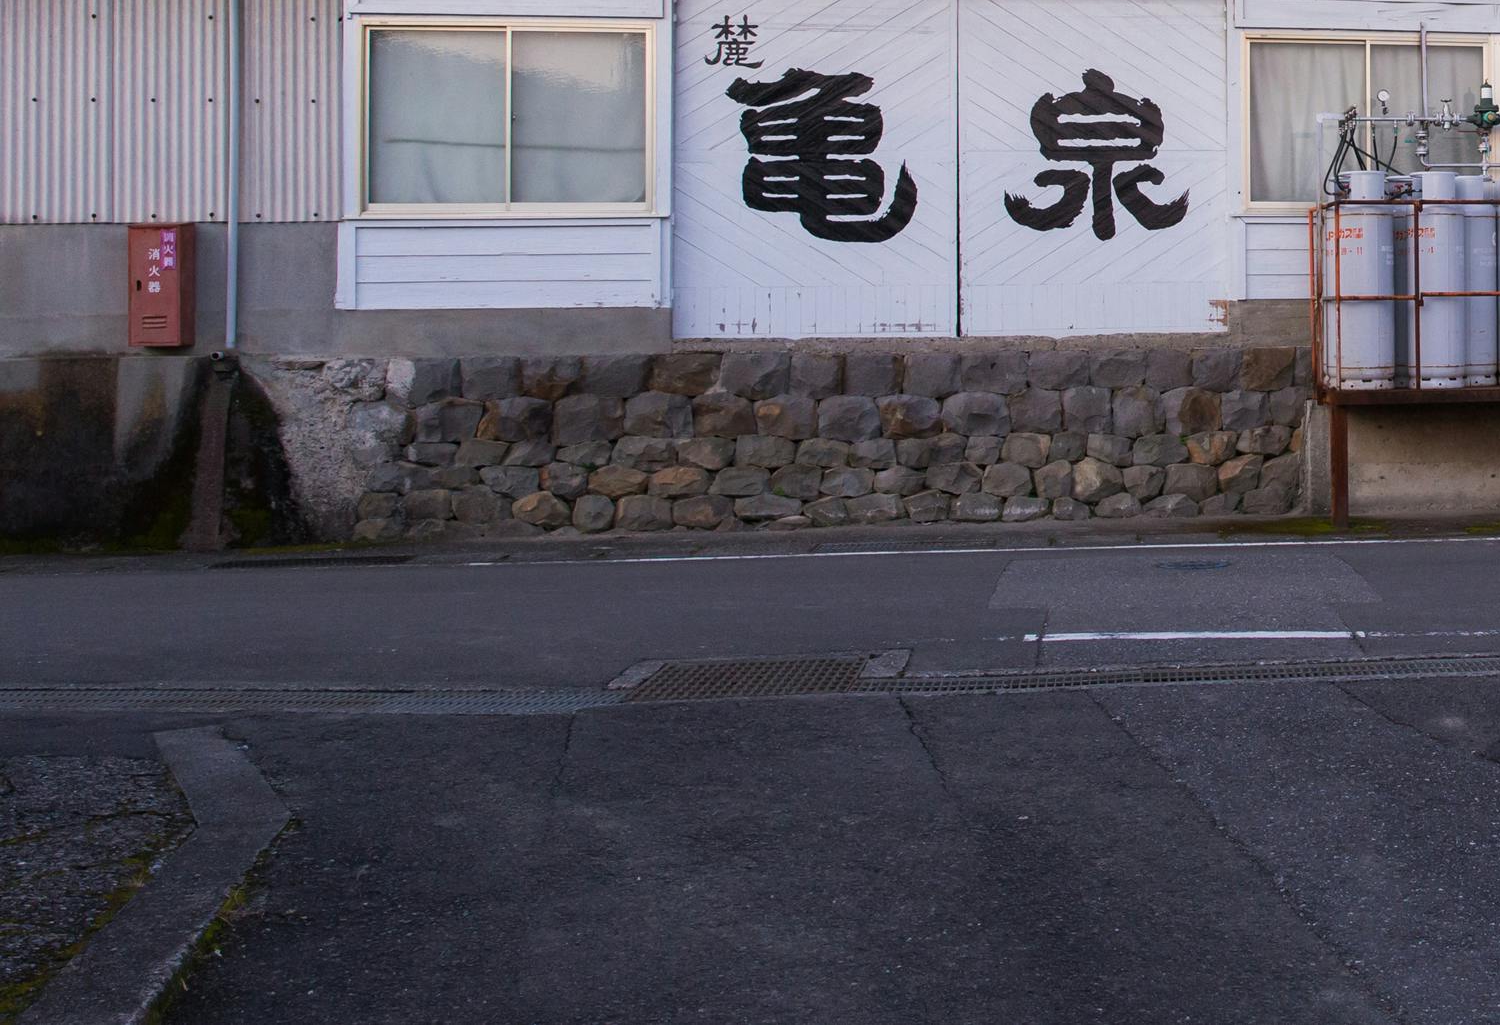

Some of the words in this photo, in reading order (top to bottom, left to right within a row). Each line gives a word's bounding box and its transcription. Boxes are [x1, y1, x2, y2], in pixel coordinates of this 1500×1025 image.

[704, 14, 764, 69] 麓
[148, 248, 160, 293] 消火器
